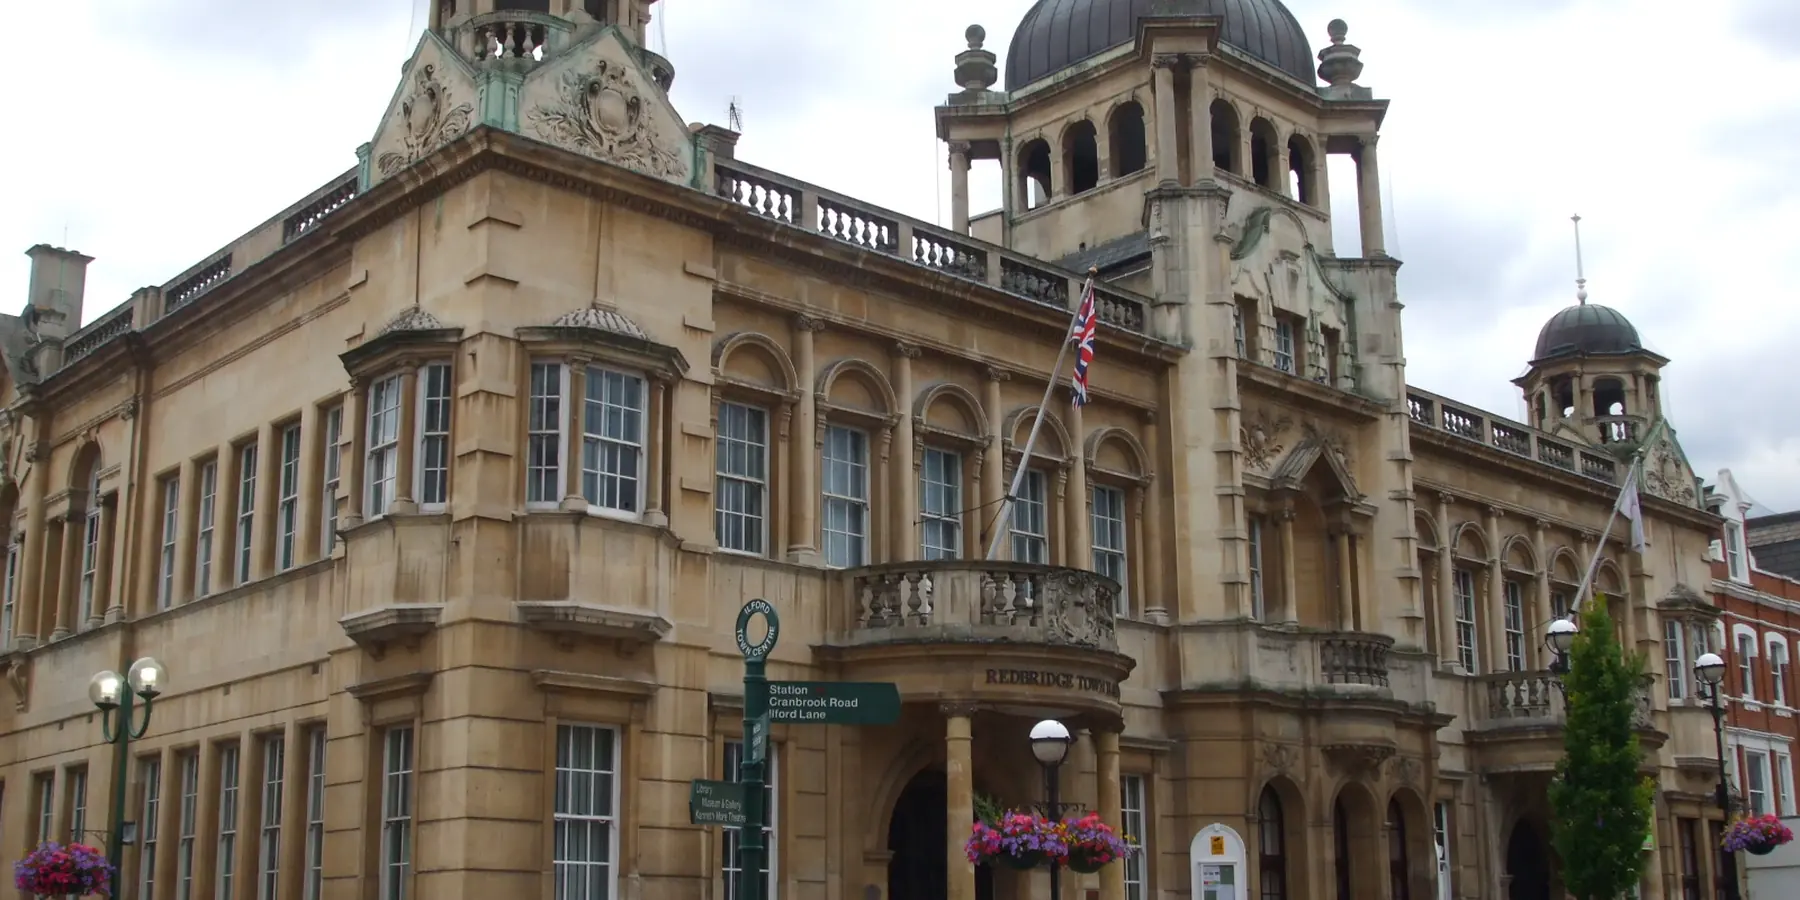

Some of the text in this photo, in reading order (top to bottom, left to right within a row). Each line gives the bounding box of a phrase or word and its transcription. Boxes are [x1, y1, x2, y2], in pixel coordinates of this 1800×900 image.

[744, 601, 770, 614] ILFORD
[737, 626, 775, 656] TOWN CENTRE
[985, 668, 1073, 688] REDBRIDGE
[769, 685, 808, 695] Station
[769, 697, 858, 707] Cranbrook Road
[769, 709, 826, 719] Ilford Lane
